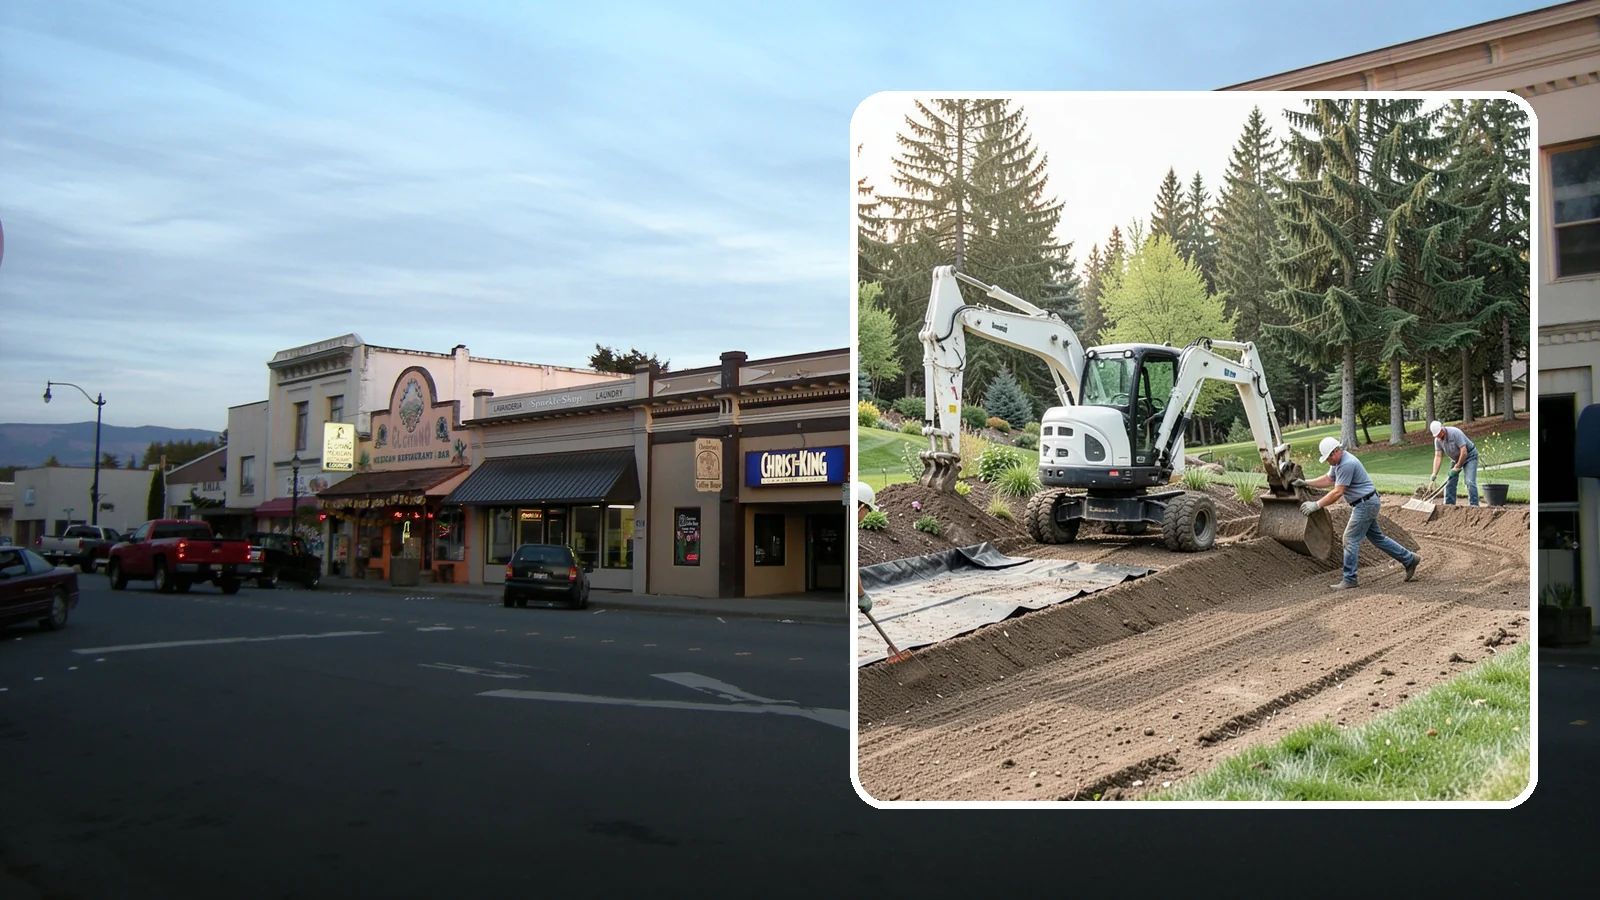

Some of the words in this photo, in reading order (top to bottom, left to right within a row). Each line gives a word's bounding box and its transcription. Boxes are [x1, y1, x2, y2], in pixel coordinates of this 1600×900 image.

[596, 389, 623, 399] LAUNDRY
[493, 402, 522, 412] LAVANDERIA
[373, 456, 396, 464] MEXICAN
[397, 452, 433, 461] RESTAURANT
[437, 450, 449, 458] BAR
[761, 452, 797, 477] CHRIST
[799, 450, 827, 476] KING
